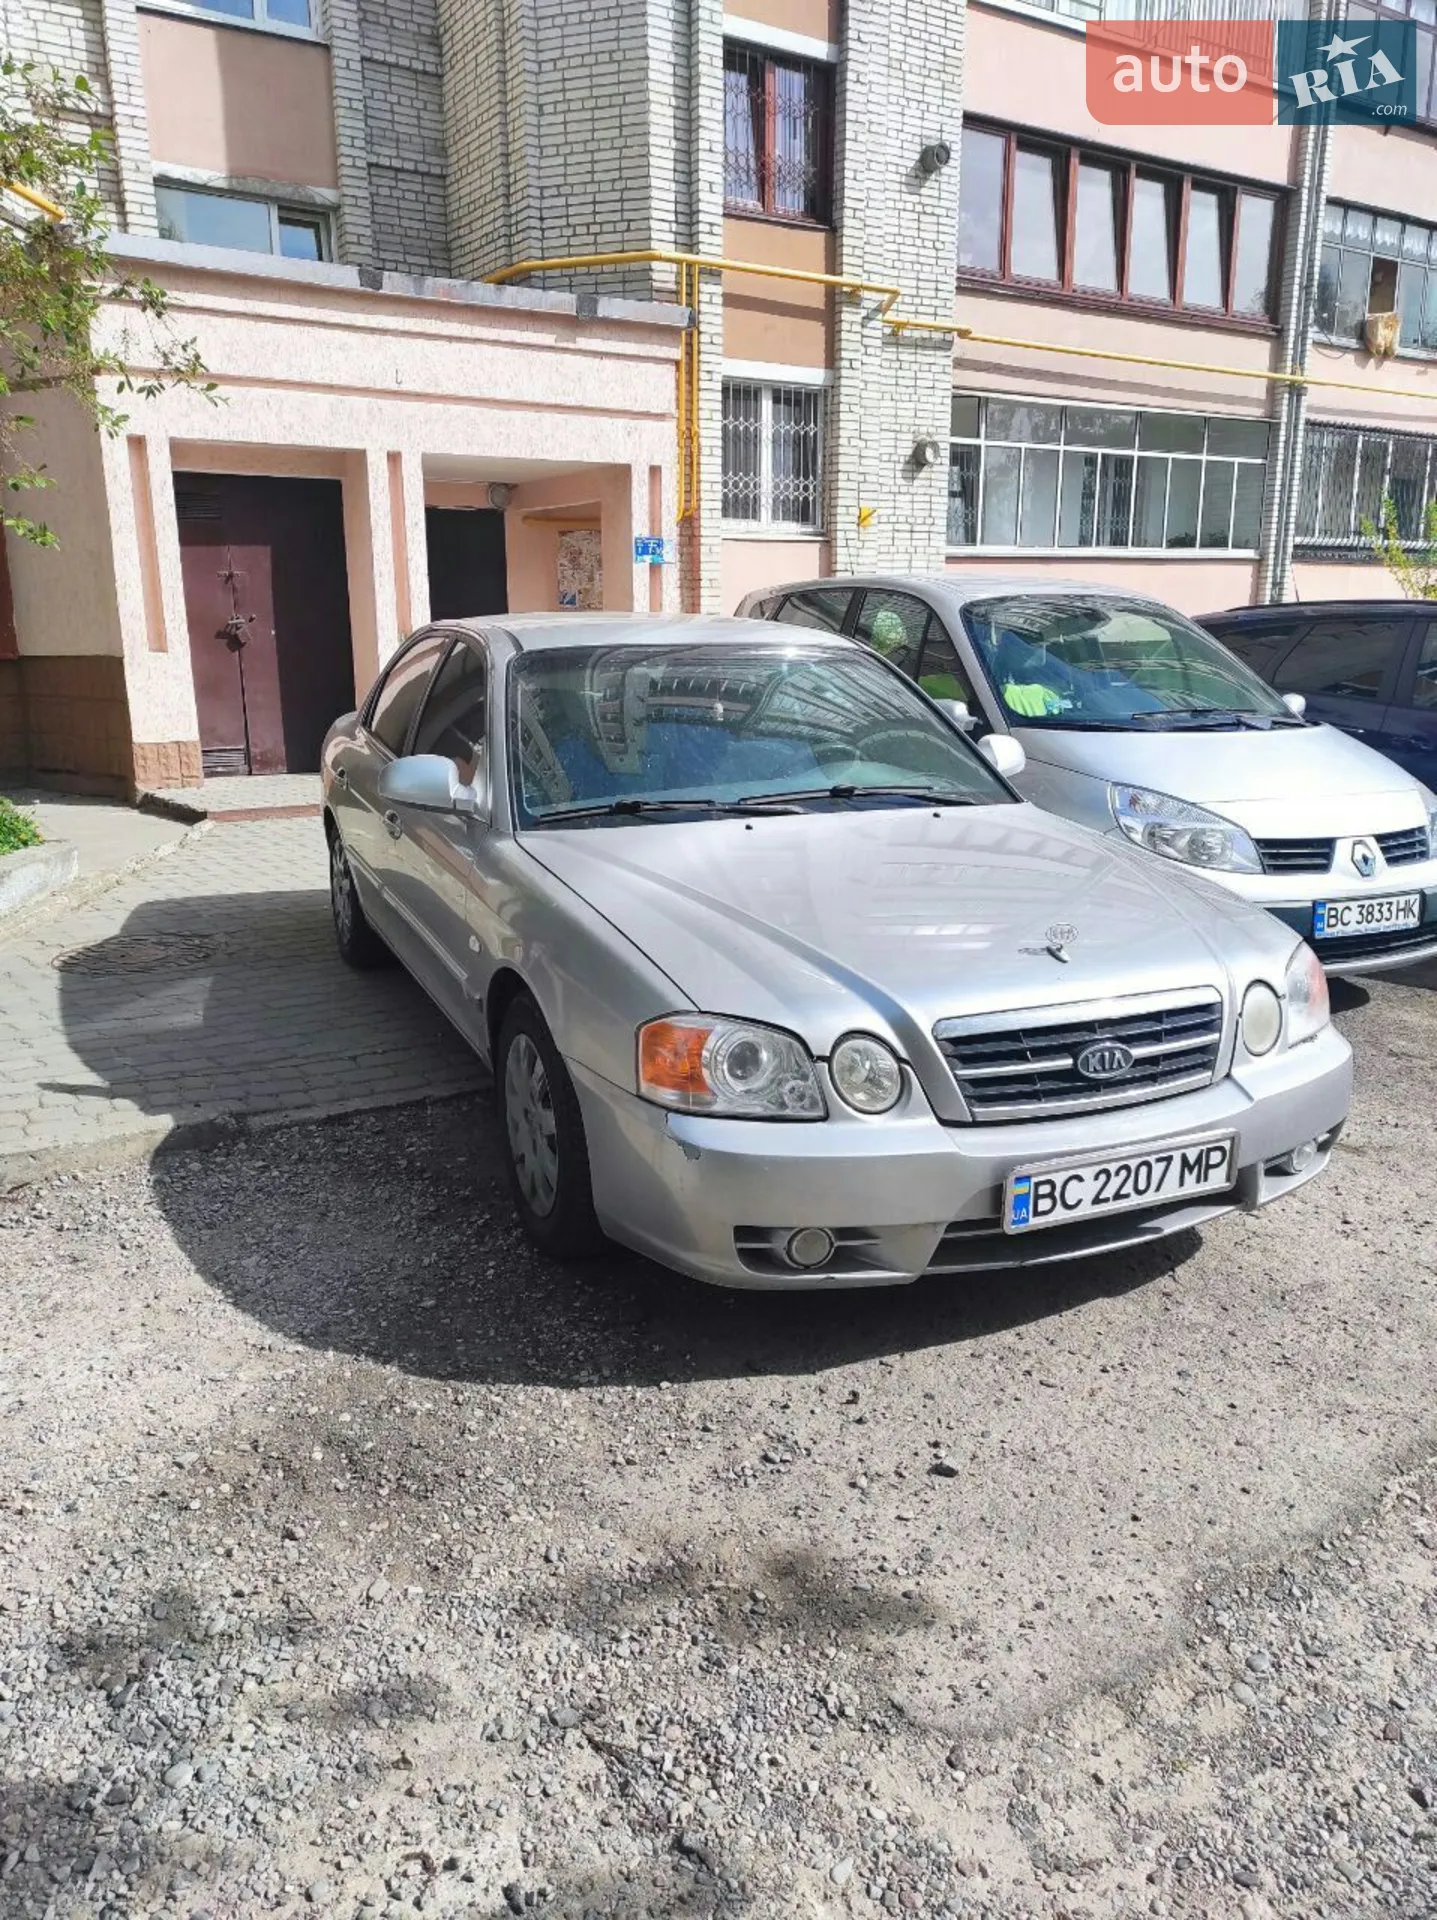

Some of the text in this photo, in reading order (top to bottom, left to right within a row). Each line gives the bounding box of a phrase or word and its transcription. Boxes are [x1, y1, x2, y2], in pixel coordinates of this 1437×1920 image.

[1327, 906, 1352, 928] BC
[1356, 902, 1393, 924] 3833
[1396, 898, 1418, 920] HK
[1087, 1051, 1126, 1072] KIA
[1032, 1145, 1228, 1218] BC 2207 MP
[1012, 1208, 1028, 1221] UA
